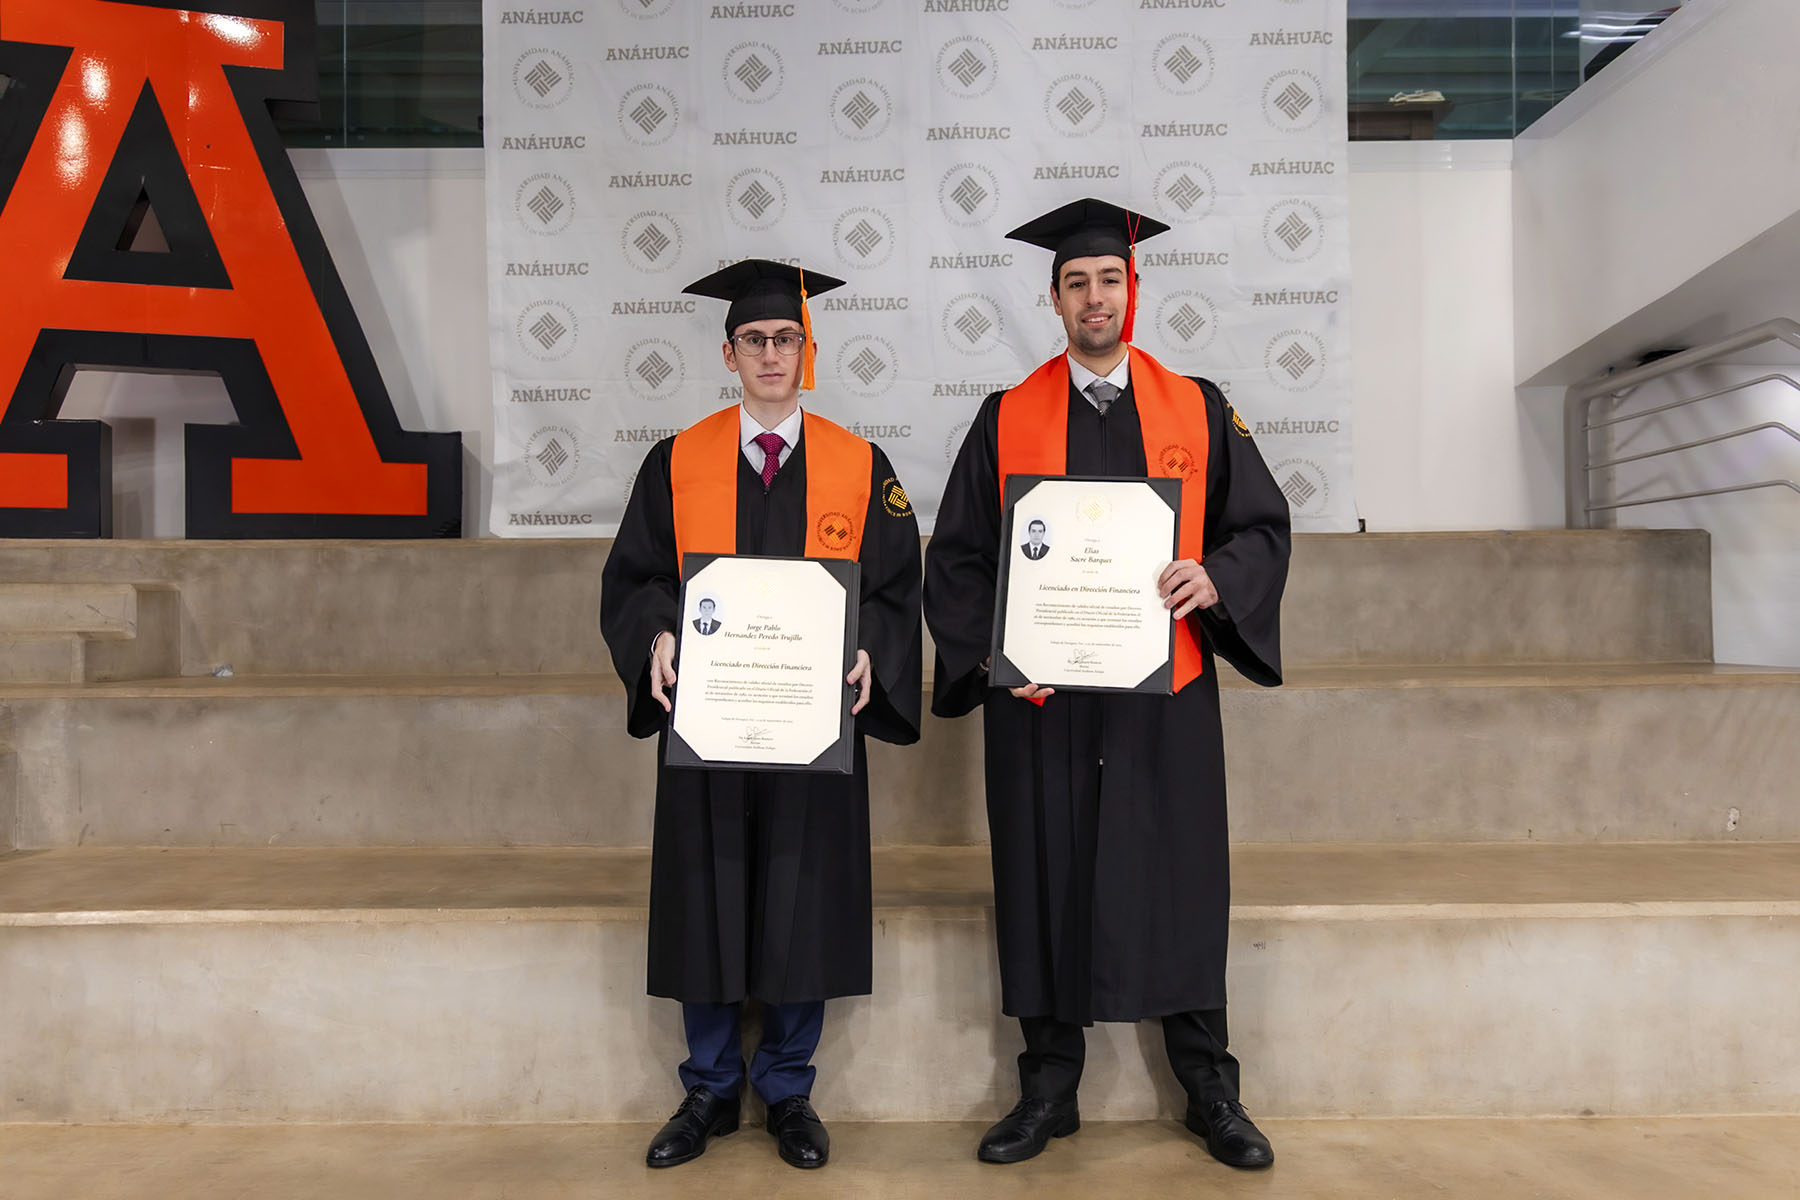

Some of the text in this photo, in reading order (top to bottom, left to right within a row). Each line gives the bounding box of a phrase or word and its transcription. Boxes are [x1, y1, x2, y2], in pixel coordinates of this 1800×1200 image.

[501, 9, 583, 24] ANÁHUAC
[711, 2, 794, 18] ANÁHUAC
[1032, 34, 1117, 50] ANÁHUAC
[1250, 29, 1332, 45] ANÁHUAC
[606, 45, 689, 60] ANÁHUAC
[818, 38, 902, 55] ANÁHUAC
[936, 36, 972, 70] UNIVERSIDAD
[1152, 32, 1188, 67] UNIVERSIDAD
[512, 46, 548, 80] UNIVERSIDAD
[722, 42, 758, 76] UNIVERSIDAD
[829, 78, 865, 113] UNIVERSIDAD
[1044, 74, 1080, 109] UNIVERSIDAD
[1262, 70, 1298, 104] UNIVERSIDAD
[618, 84, 654, 118] UNIVERSIDAD
[713, 128, 797, 145] ANÁHUAC
[927, 123, 1010, 140] ANÁHUAC
[1141, 121, 1227, 137] ANÁHUAC
[502, 134, 585, 150] ANÁHUAC
[820, 167, 904, 183] ANÁHUAC
[1034, 163, 1119, 179] ANÁHUAC
[1250, 158, 1334, 176] ANÁHUAC
[609, 171, 691, 188] ANÁHUAC
[725, 168, 761, 202] UNIVERSIDAD
[937, 164, 973, 198] UNIVERSIDAD
[514, 174, 550, 208] UNIVERSIDAD
[832, 206, 868, 241] UNIVERSIDAD
[1263, 199, 1299, 234] UNIVERSIDAD
[620, 212, 656, 246] UNIVERSIDAD
[930, 252, 1012, 268] ANÁHUAC
[1144, 250, 1229, 266] ANÁHUAC
[506, 260, 588, 276] ANÁHUAC
[824, 295, 908, 310] ANÁHUAC
[1252, 288, 1338, 305] ANÁHUAC
[612, 298, 695, 314] ANÁHUAC
[942, 294, 978, 328] UNIVERSIDAD
[516, 300, 552, 334] UNIVERSIDAD
[624, 338, 660, 372] UNIVERSIDAD
[836, 335, 872, 369] UNIVERSIDAD
[511, 386, 590, 402] ANÁHUAC
[1254, 417, 1339, 434] ANÁHUAC
[524, 425, 558, 460] UNIVERSIDAD
[509, 511, 592, 525] ANÁHUAC
[1039, 584, 1070, 592] Licenciado
[1080, 586, 1108, 594] Dirección
[747, 624, 762, 632] Jorge
[780, 634, 802, 642] Trujillo
[710, 660, 742, 668] Licenciado
[752, 662, 780, 670] Dirección
[781, 663, 812, 671] Financiera
